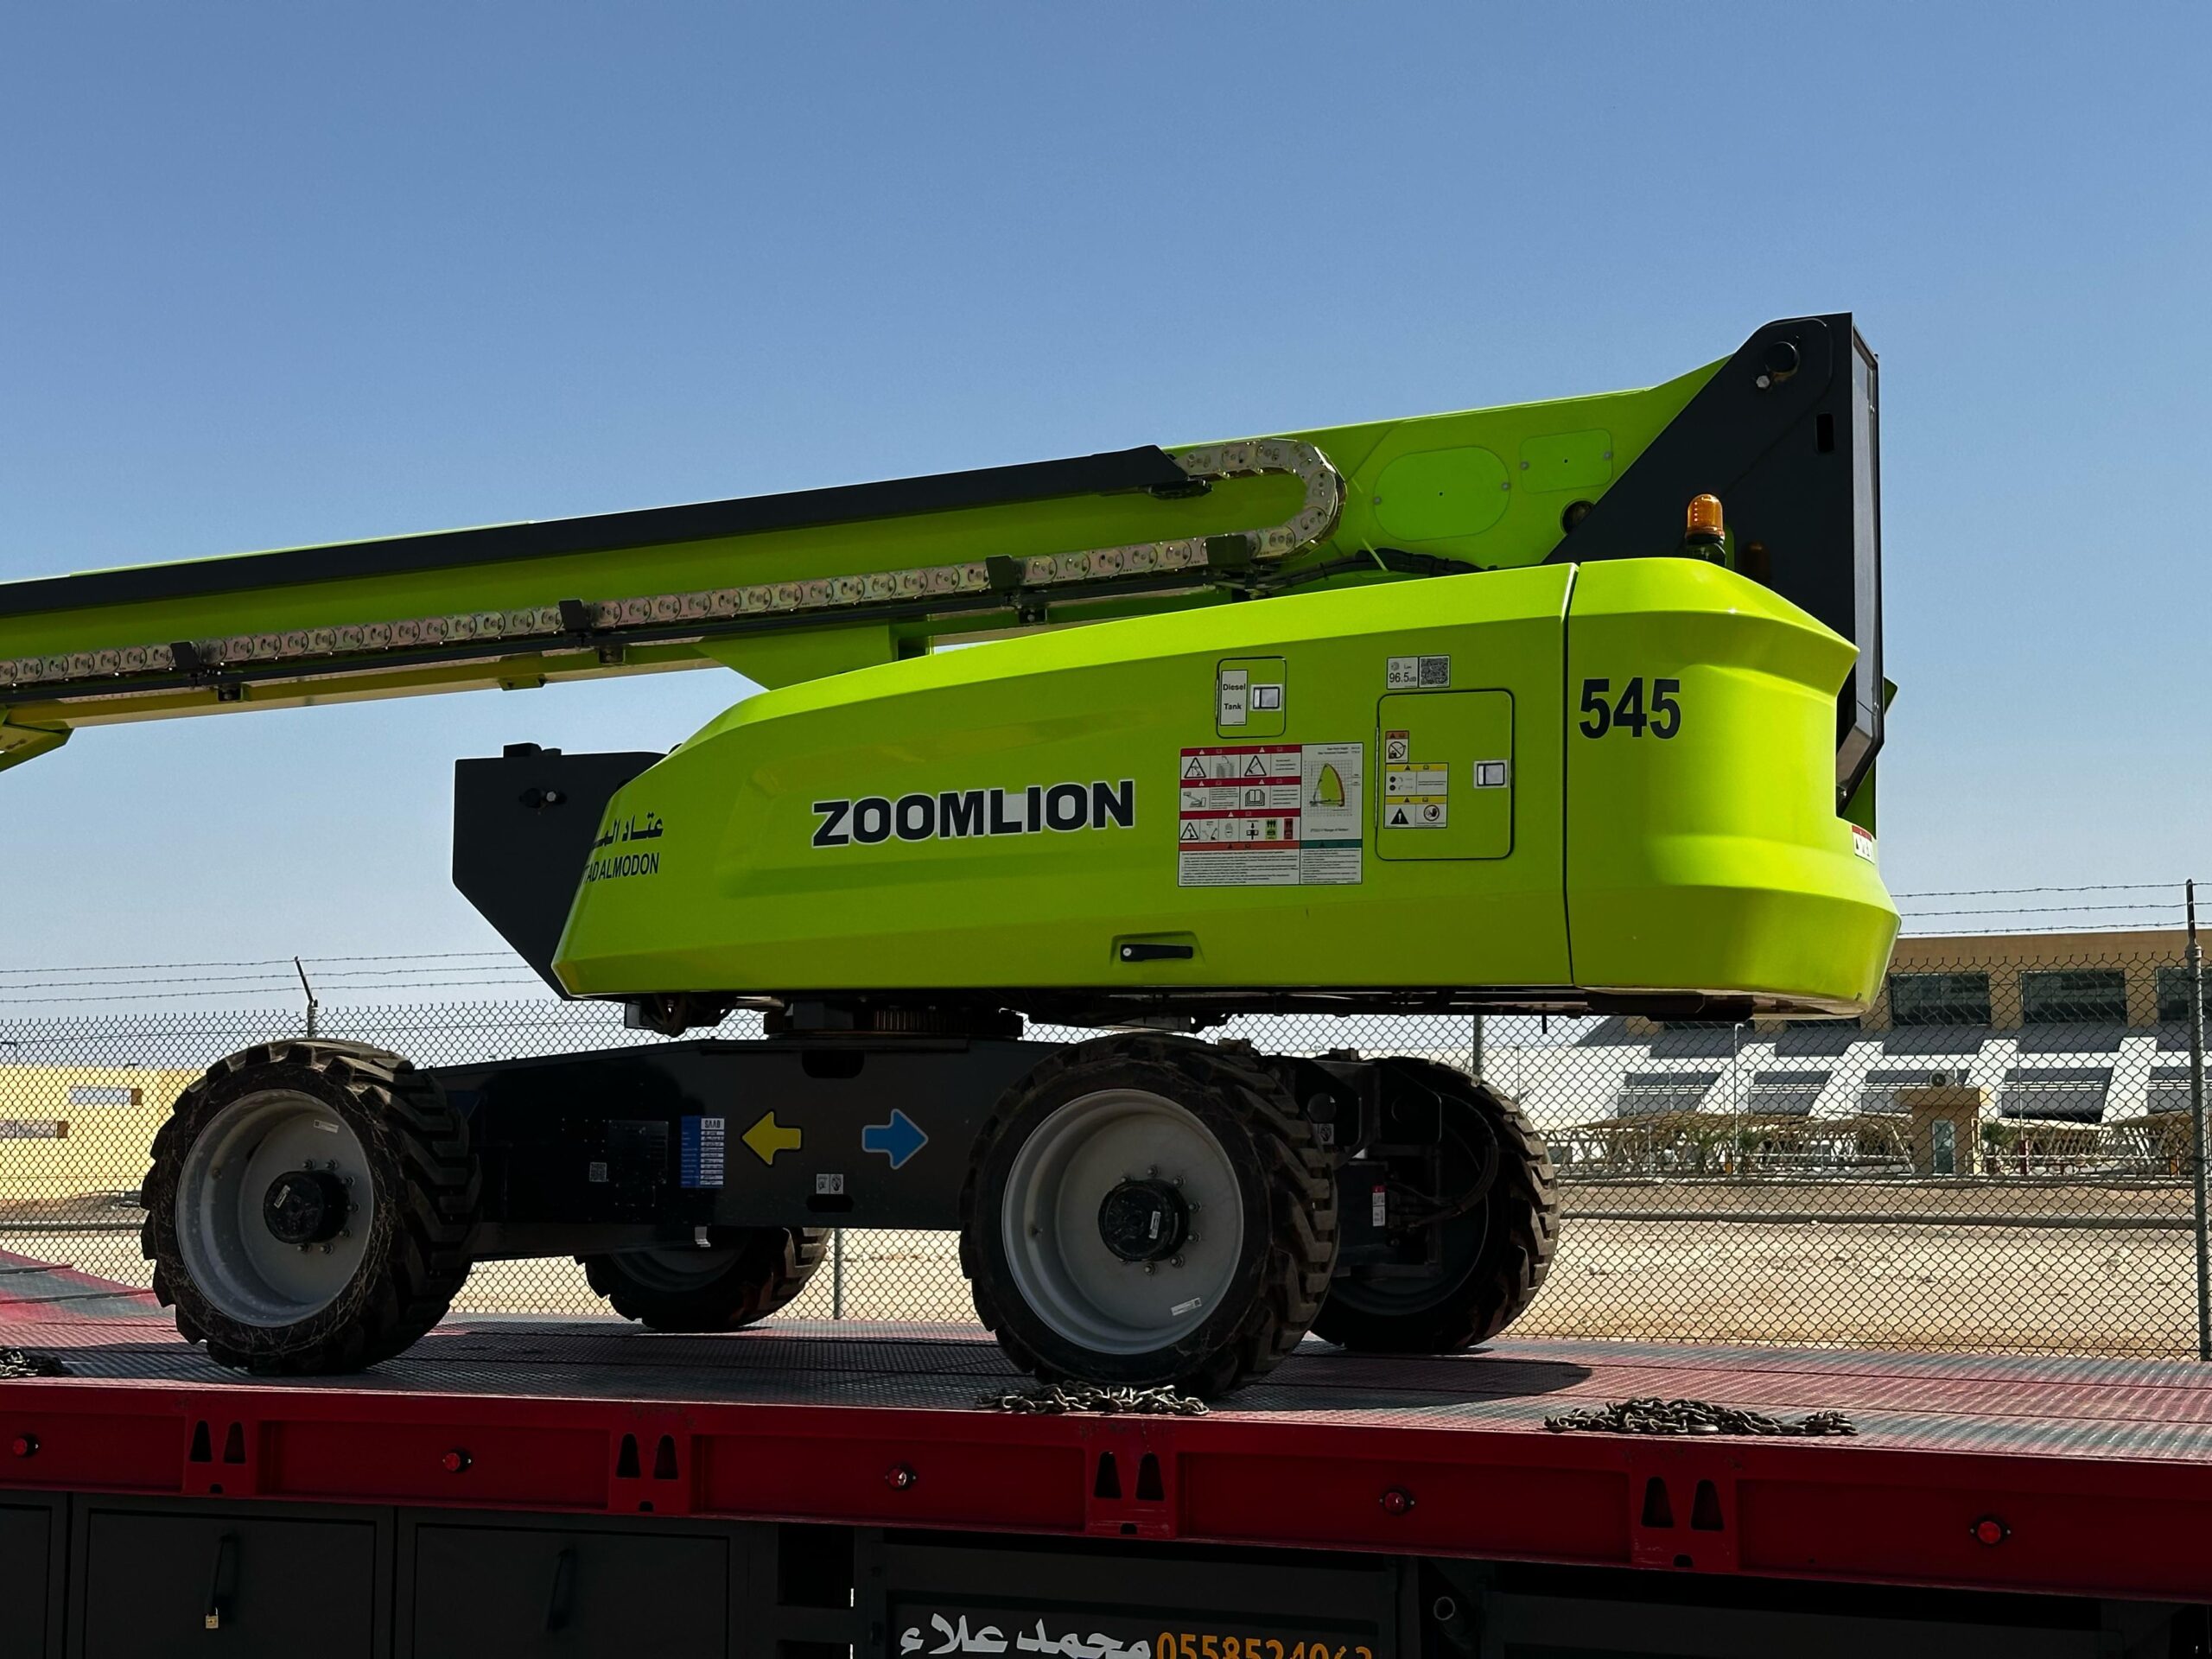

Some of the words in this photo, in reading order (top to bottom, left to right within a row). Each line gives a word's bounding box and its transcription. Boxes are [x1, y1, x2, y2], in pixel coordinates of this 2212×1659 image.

[1223, 683, 1246, 691] Diesel
[1579, 677, 1681, 739] 545
[812, 779, 1134, 847] ZOOMLION
[598, 852, 660, 880] ALMODON
[899, 1612, 1009, 1656] علاء
